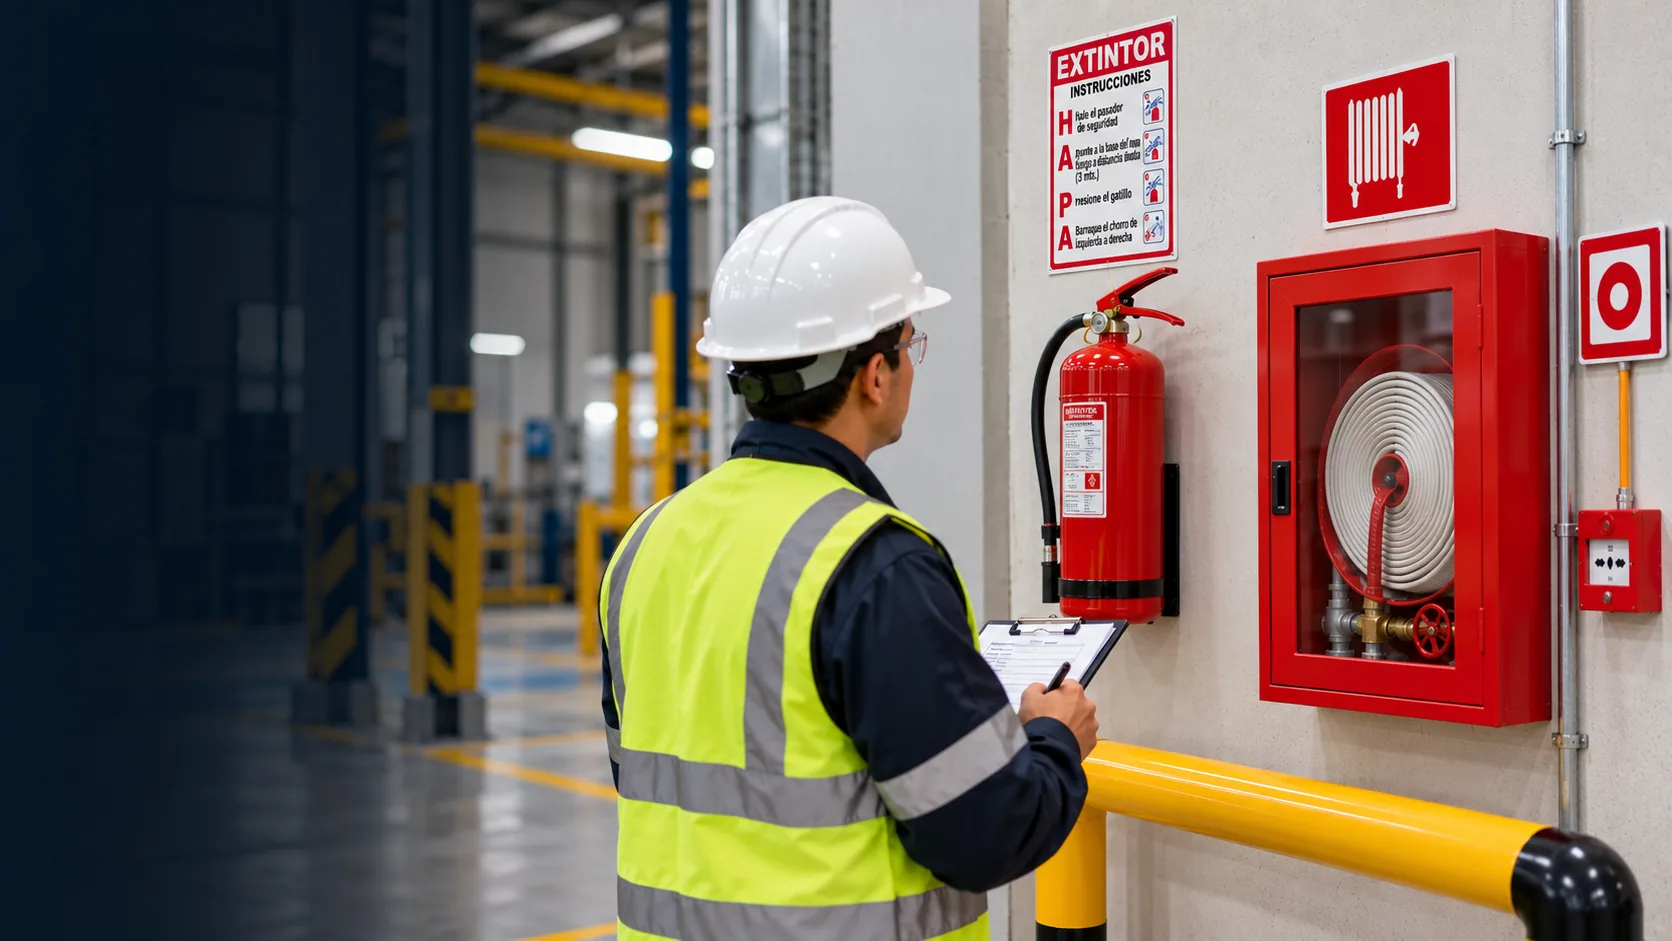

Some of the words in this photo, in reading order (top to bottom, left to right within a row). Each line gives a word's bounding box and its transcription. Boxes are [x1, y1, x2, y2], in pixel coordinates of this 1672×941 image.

[1057, 31, 1166, 80] EXTINTOR
[1070, 69, 1151, 99] INSTRUCCIONES
[1058, 109, 1073, 137] H
[1077, 122, 1085, 133] de
[1058, 144, 1073, 171] A
[1075, 171, 1082, 185] (3
[1059, 192, 1072, 218] P
[1102, 191, 1109, 202] el
[1110, 188, 1132, 204] gatillo
[1103, 221, 1108, 232] el
[1130, 217, 1137, 228] de
[1058, 225, 1073, 251] A
[1103, 237, 1108, 245] a
